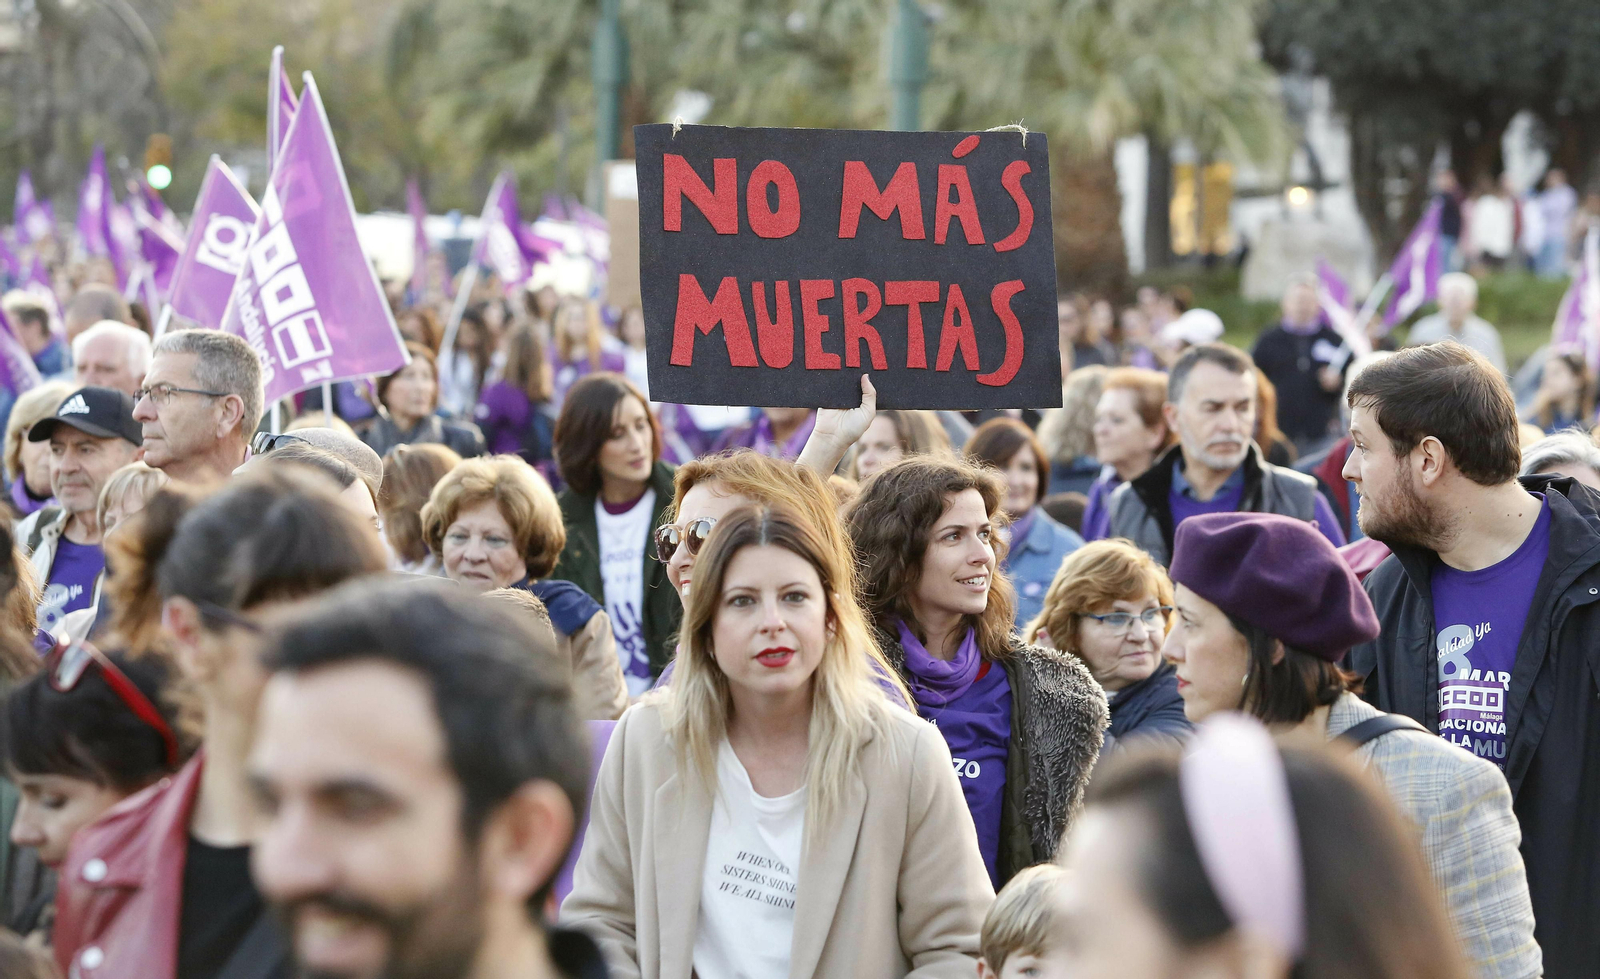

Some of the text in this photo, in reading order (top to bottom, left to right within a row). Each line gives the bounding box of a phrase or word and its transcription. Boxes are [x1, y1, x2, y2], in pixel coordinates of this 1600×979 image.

[663, 136, 1034, 252] NO MÁS
[671, 274, 1025, 386] MUERTAS
[1437, 621, 1492, 661] aldad Ya
[1436, 624, 1475, 683] 8
[1459, 668, 1511, 690] MAR
[1480, 712, 1503, 721] Málaga
[1451, 733, 1472, 748] LA
[737, 851, 774, 869] WHEN
[721, 865, 768, 885] SISTERS
[719, 882, 743, 896] WE
[741, 889, 763, 902] ALL
